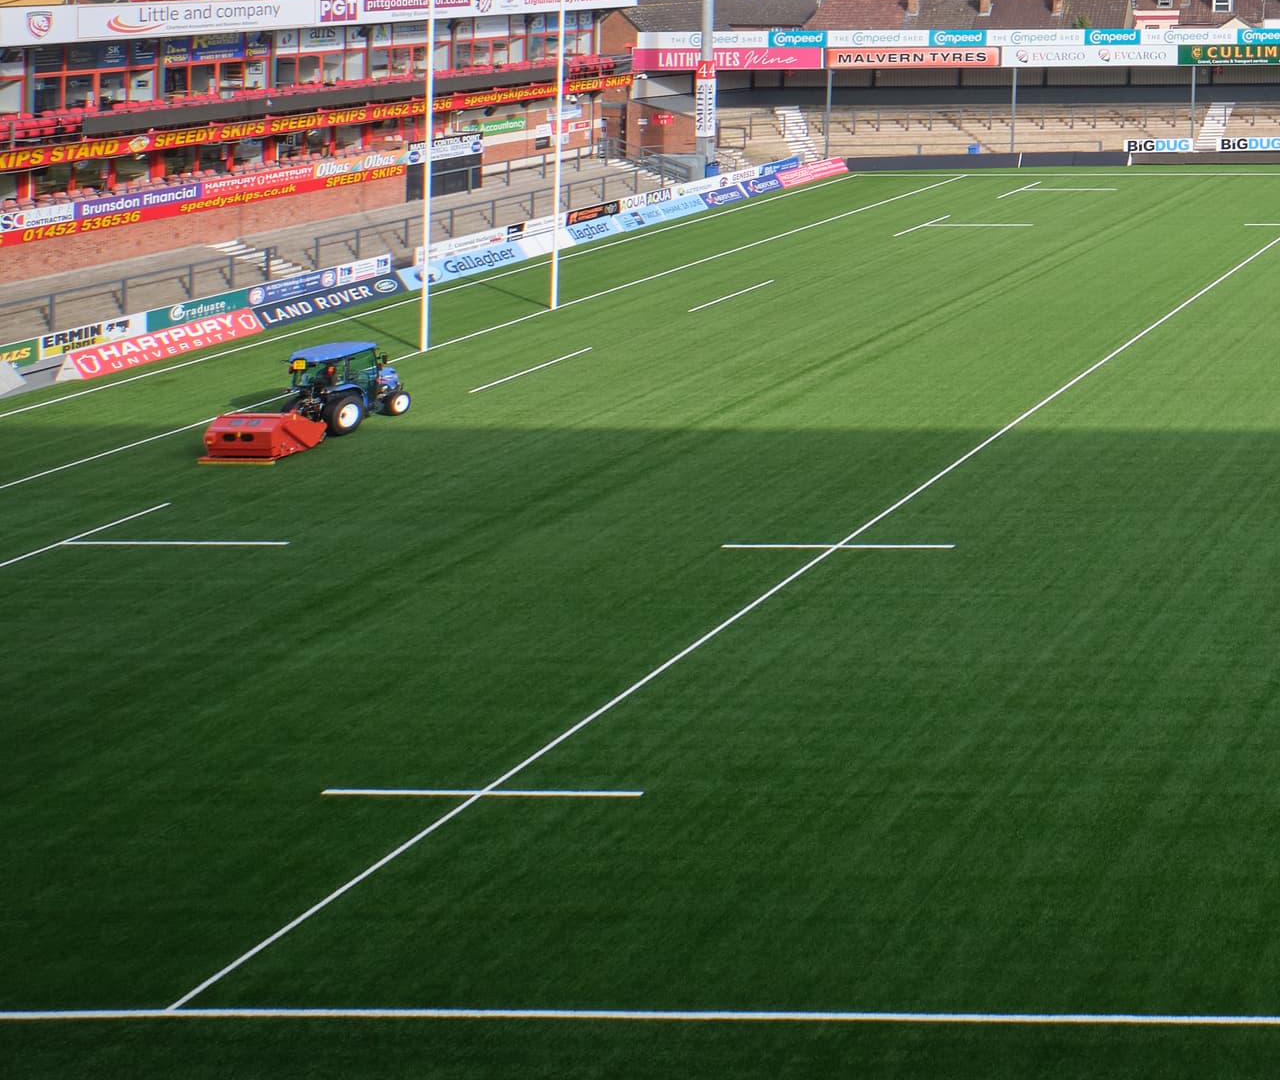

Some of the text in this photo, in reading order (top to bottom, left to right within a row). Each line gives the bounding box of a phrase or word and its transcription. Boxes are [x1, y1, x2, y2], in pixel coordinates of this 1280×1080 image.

[139, 4, 281, 23] Little and company
[773, 32, 824, 47] Compeed
[934, 31, 982, 45] Compeed
[1090, 31, 1136, 44] Compeed
[659, 51, 740, 67] LAITHWITES
[838, 52, 986, 63] MALVERN TYRES
[698, 62, 716, 77] 44
[569, 75, 631, 92] SPEEDY SKIPS
[373, 97, 452, 118] 01452 53536
[271, 110, 366, 133] SPEEDY SKIPS
[154, 122, 265, 148] SPEEDY SKIPS
[50, 140, 119, 162] STAND
[317, 162, 350, 178] Olbas
[364, 153, 395, 169] Olbas
[265, 166, 313, 179] HARTPURY
[326, 166, 403, 188] SPEEDY SKIPS
[205, 176, 257, 190] HARTPURY
[82, 196, 140, 216] Brunsdon
[143, 186, 197, 206] Financial
[180, 183, 296, 212] speedyskips.co.uk
[621, 194, 646, 211] AQUA
[646, 188, 671, 206] AQUA
[23, 211, 141, 242] 01452 536536
[444, 246, 516, 274] Gallagher
[169, 301, 226, 321] Graduate
[262, 300, 312, 324] LAND
[315, 285, 373, 310] ROVER
[43, 324, 102, 348] ERMIN
[63, 337, 96, 353] plant
[98, 314, 233, 361] HARTPURY
[112, 330, 236, 369] UNIVERSITY
